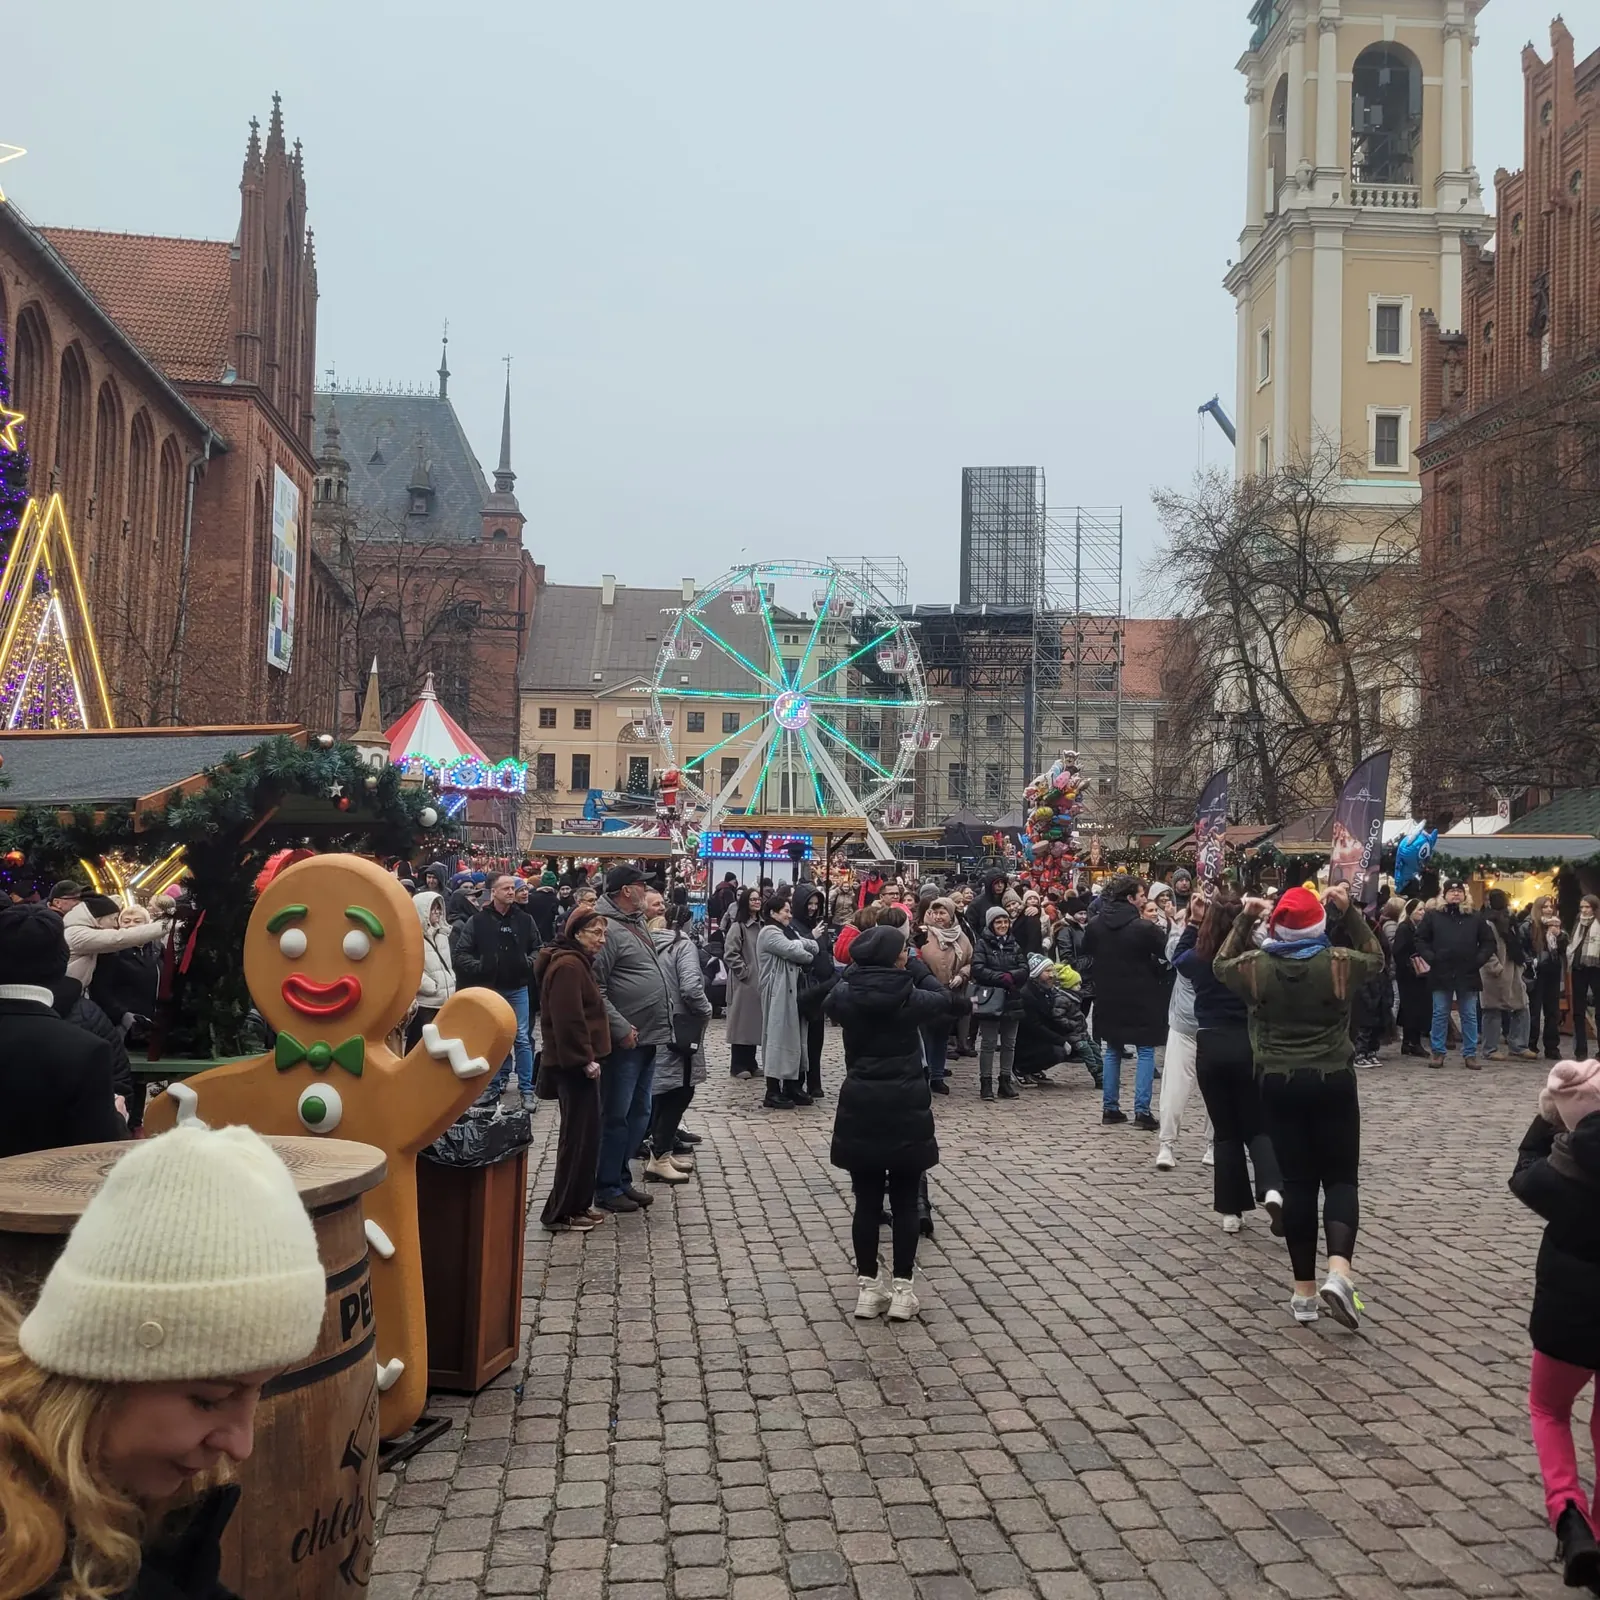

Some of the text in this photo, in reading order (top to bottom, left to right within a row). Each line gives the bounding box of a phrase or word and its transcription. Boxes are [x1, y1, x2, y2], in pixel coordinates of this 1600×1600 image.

[779, 699, 806, 710] URO
[1352, 872, 1365, 889] NA
[340, 1277, 374, 1343] PE
